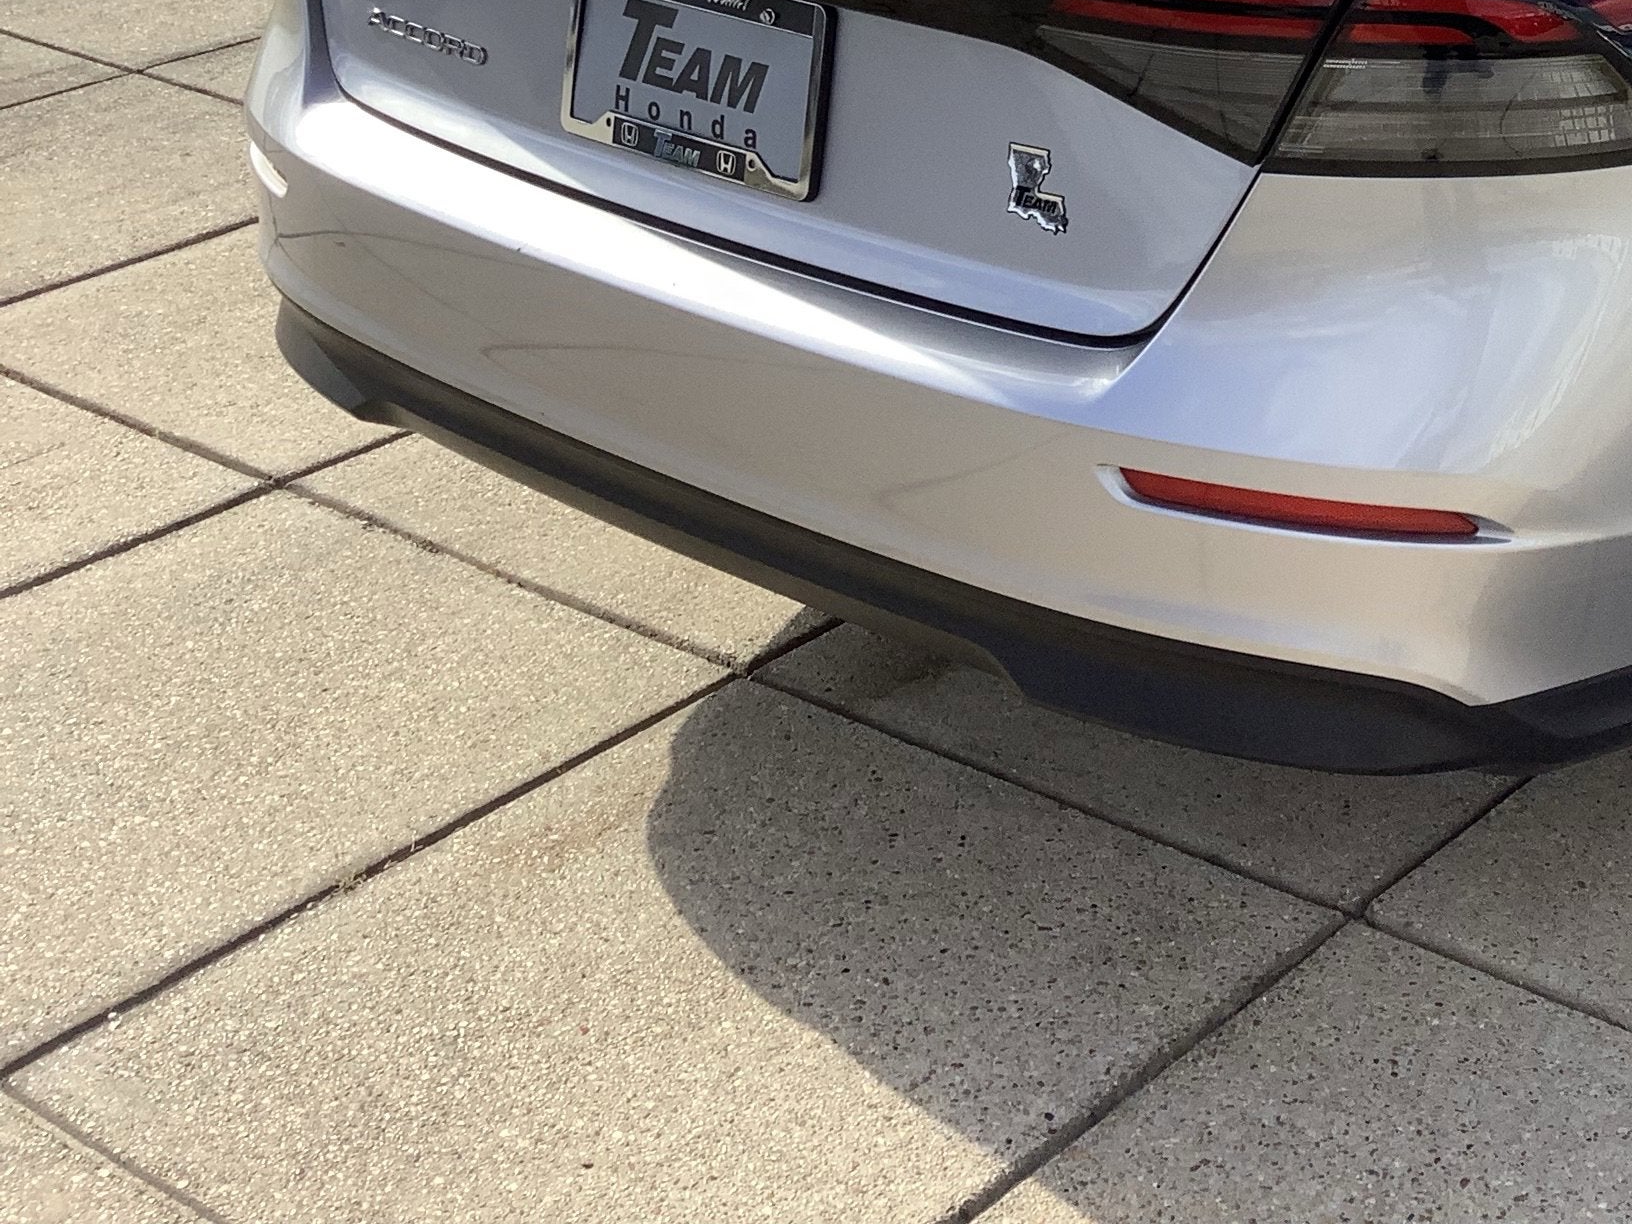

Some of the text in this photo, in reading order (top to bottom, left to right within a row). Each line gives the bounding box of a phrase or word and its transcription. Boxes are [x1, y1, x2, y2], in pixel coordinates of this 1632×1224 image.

[368, 7, 489, 66] ACCORD
[614, 84, 758, 151] Honda
[653, 129, 701, 168] TEAM
[1015, 185, 1058, 214] TEAM
